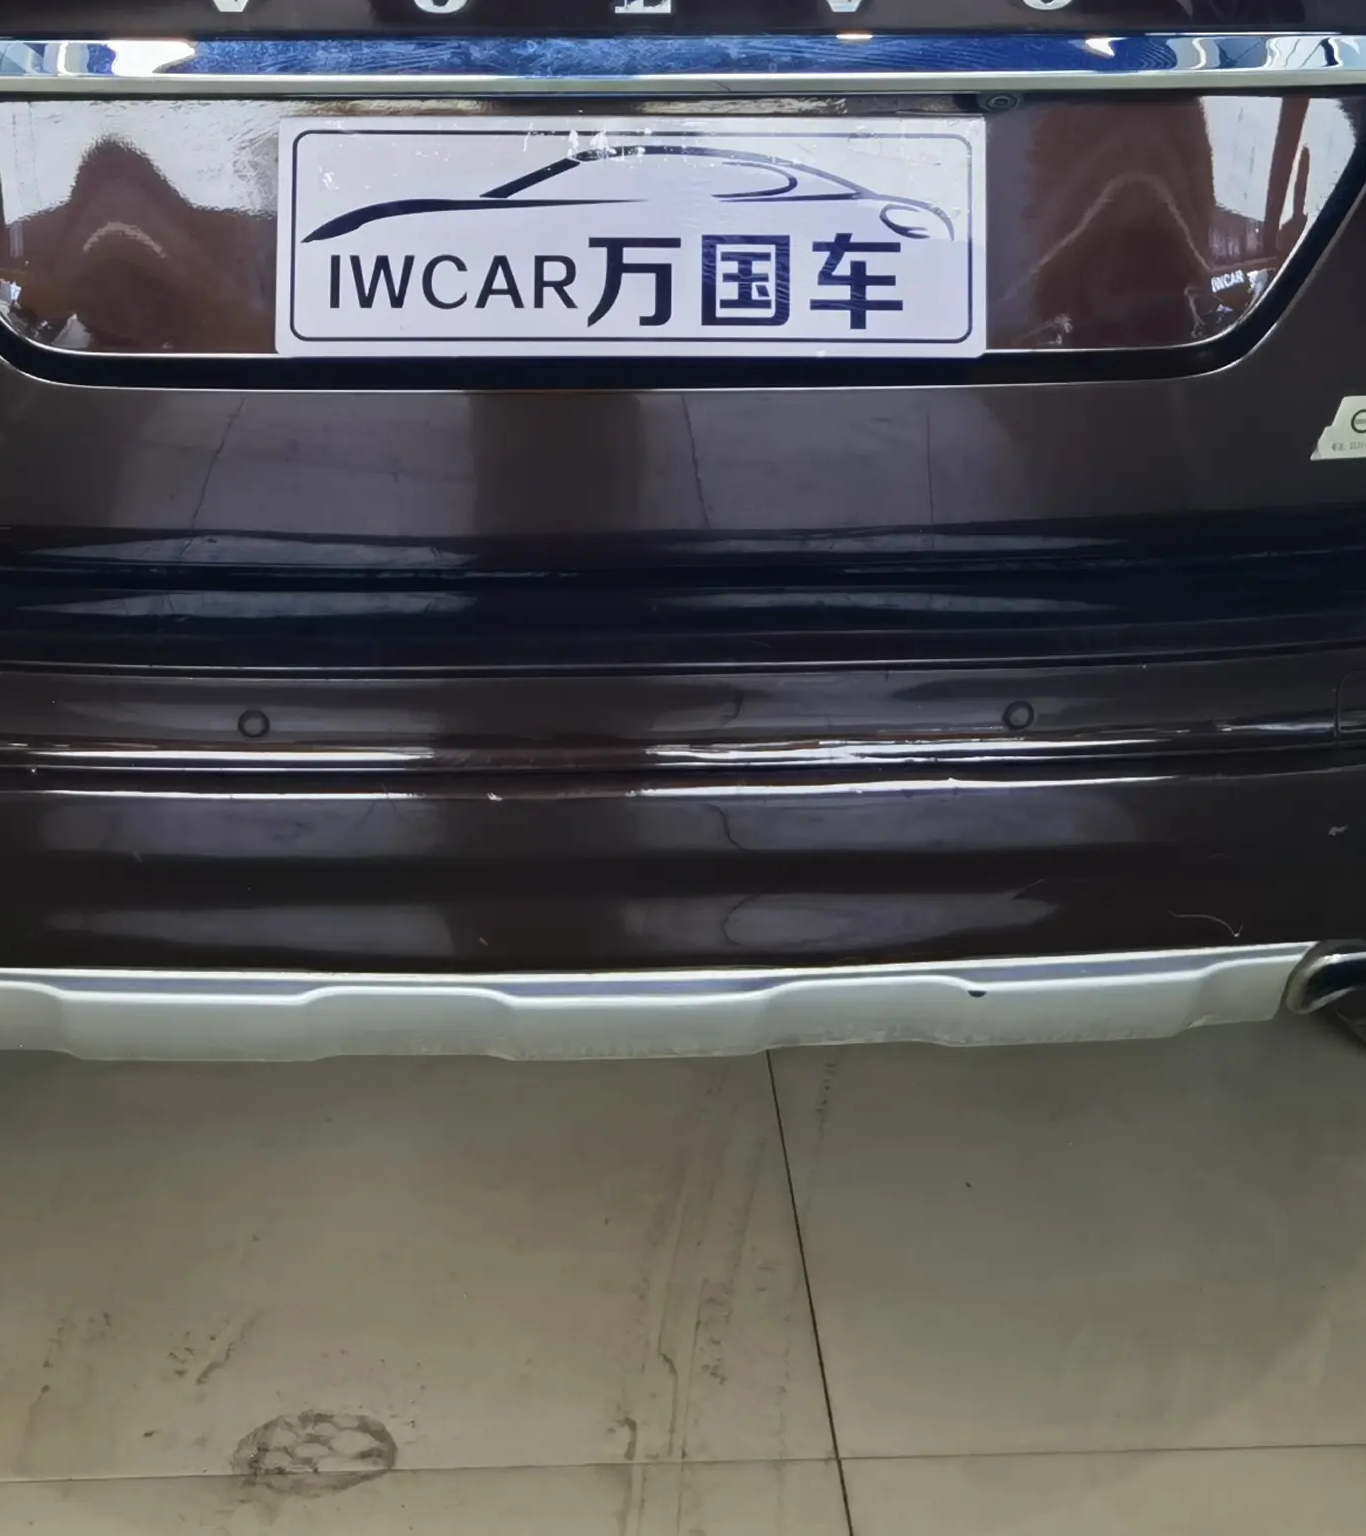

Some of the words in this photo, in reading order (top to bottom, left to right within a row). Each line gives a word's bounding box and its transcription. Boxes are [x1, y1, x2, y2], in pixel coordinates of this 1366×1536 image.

[329, 254, 577, 309] IWCAR
[587, 232, 903, 330] 万国车
